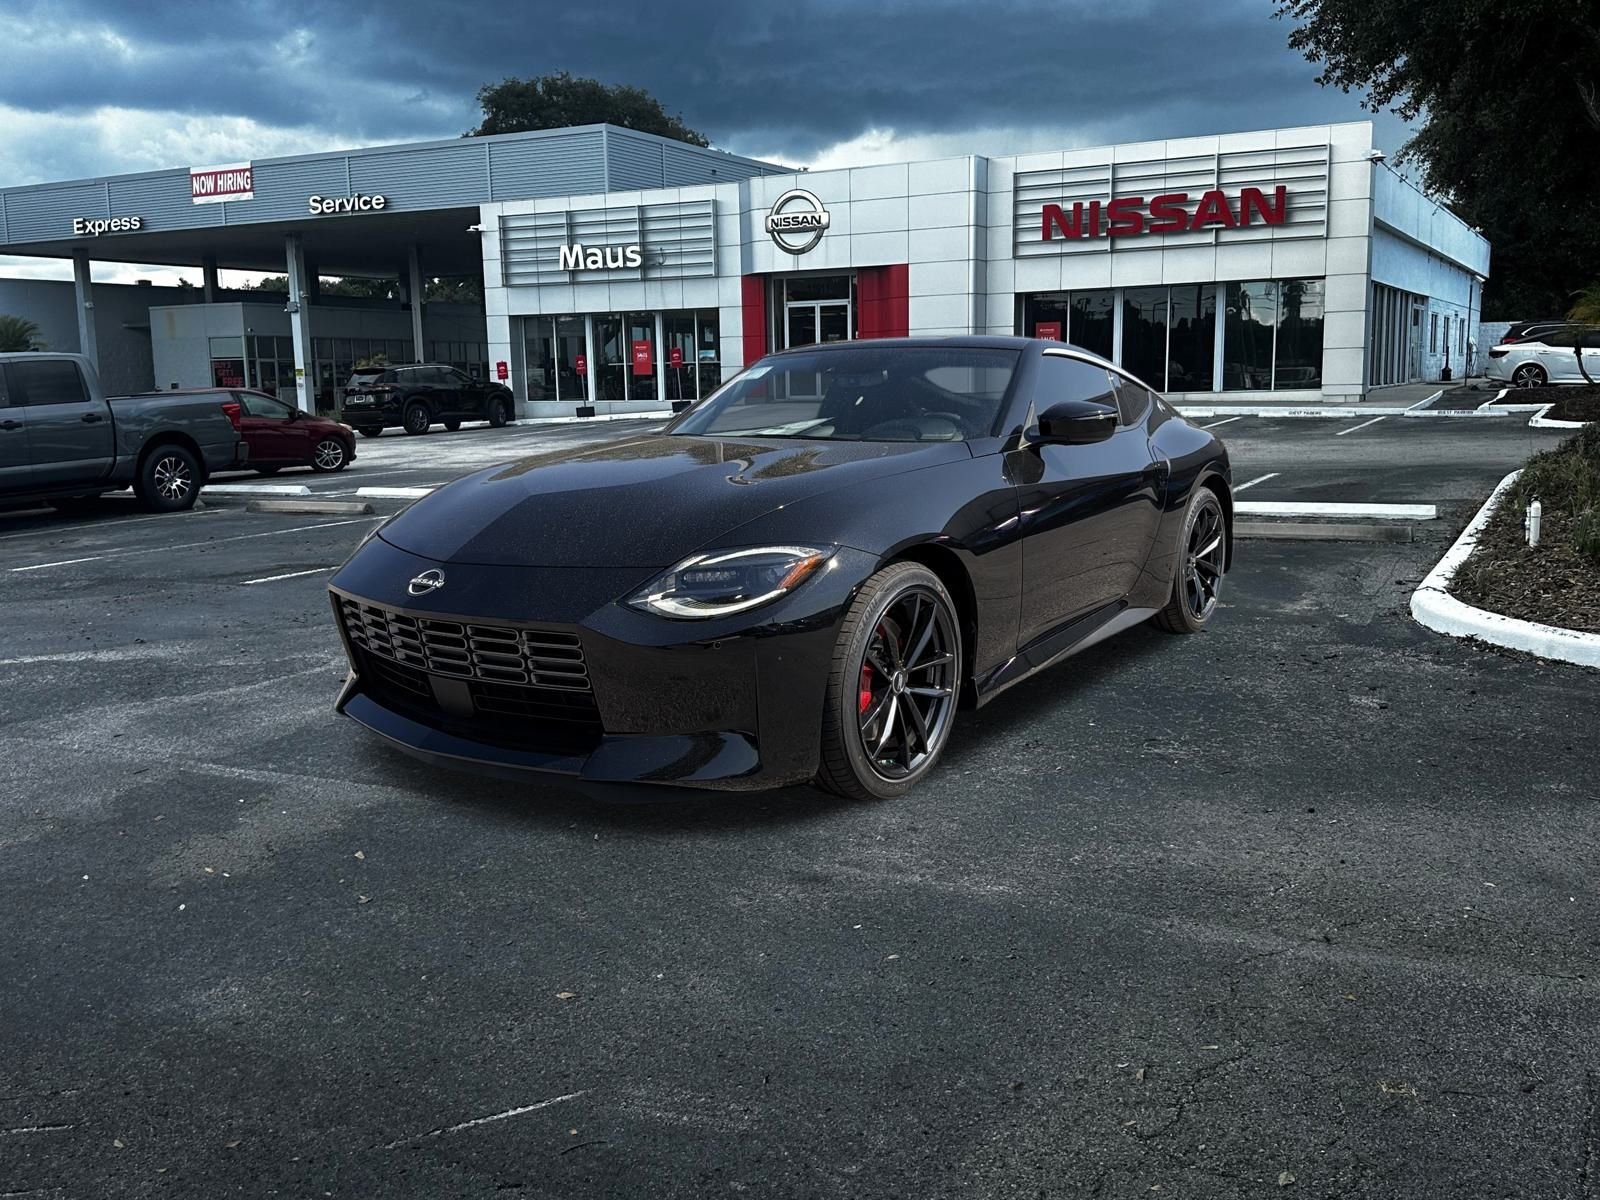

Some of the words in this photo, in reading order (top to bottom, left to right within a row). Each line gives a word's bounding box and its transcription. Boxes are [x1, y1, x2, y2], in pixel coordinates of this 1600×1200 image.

[192, 174, 216, 195] NOW
[216, 171, 251, 193] HIRING
[308, 192, 385, 215] Service
[1042, 185, 1287, 241] NISSAN
[73, 216, 141, 237] Express
[770, 214, 822, 228] NISSAN
[559, 243, 642, 270] Maus
